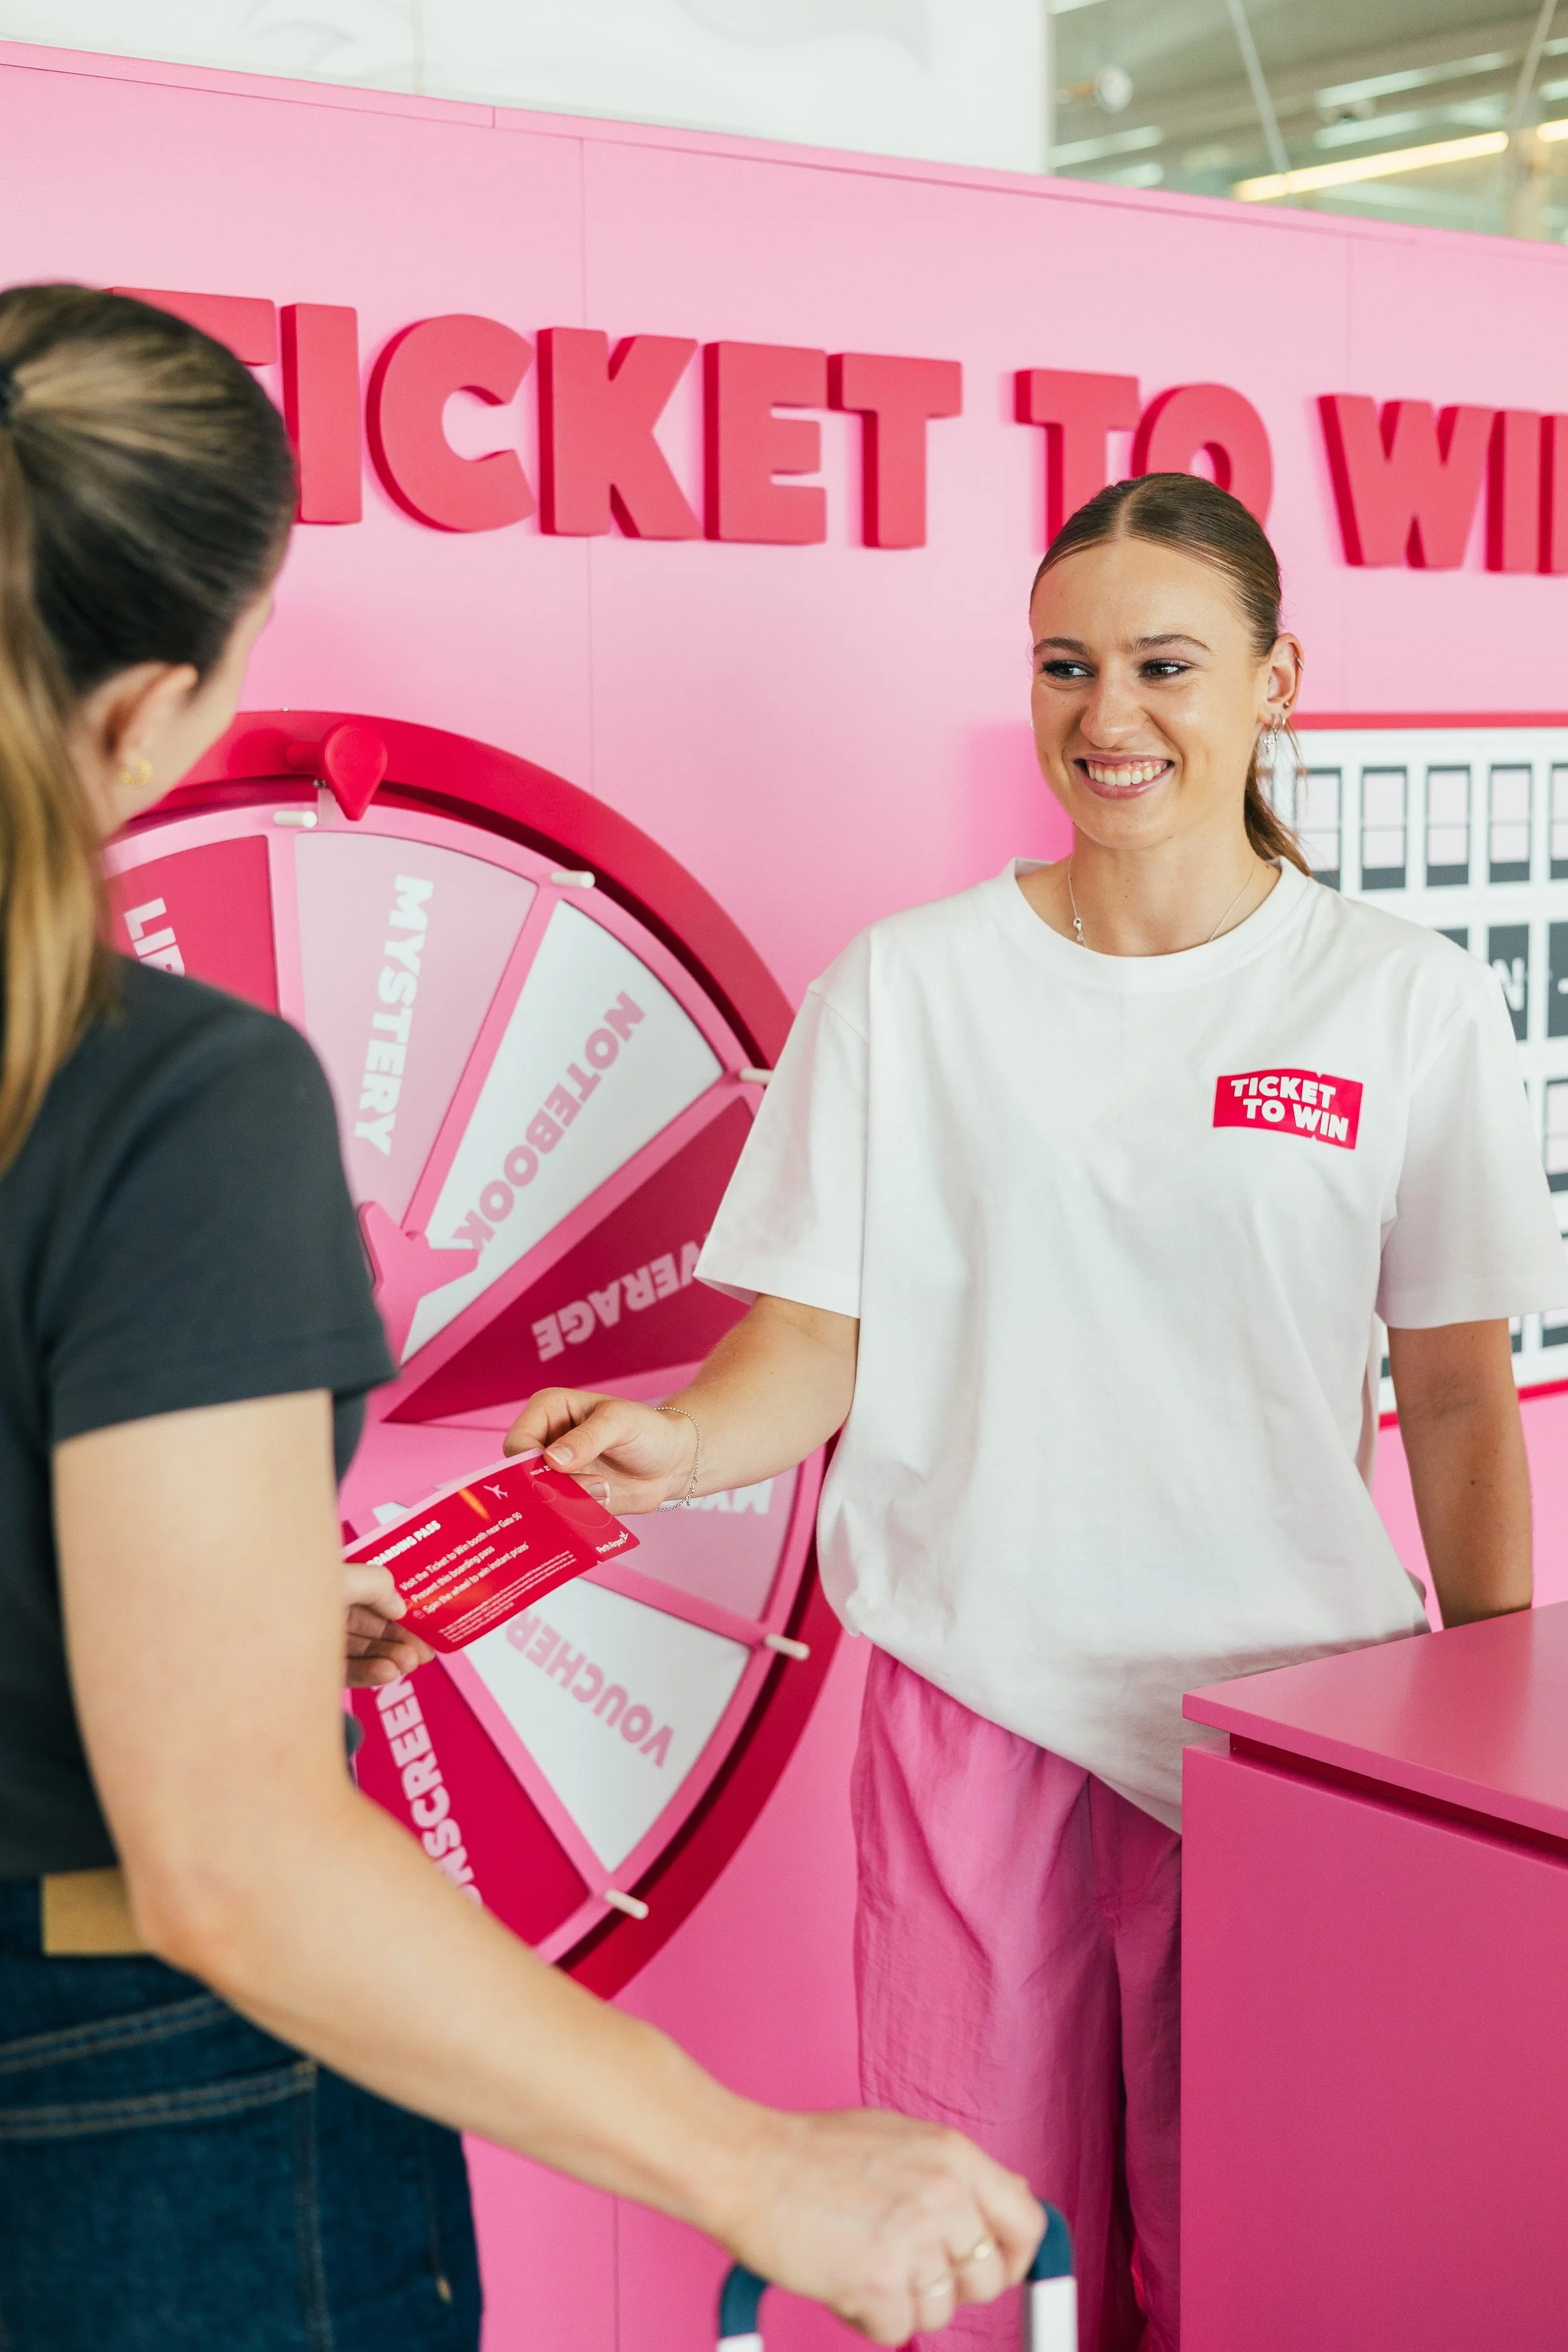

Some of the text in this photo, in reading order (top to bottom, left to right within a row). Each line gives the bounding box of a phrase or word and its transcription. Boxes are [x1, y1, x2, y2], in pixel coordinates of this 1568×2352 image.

[1015, 368, 1273, 551] TO
[1316, 394, 1568, 575] WI
[354, 874, 433, 1156] MYSTERY
[451, 990, 646, 1254] NOTEBOOK
[1231, 1076, 1336, 1109] TICKET
[1242, 1098, 1348, 1142] TO WIN
[531, 1233, 707, 1362] VERAGE
[399, 1512, 522, 1591] Visit the Ticket to Win booth near Gate 50
[413, 1520, 441, 1542] PASS
[596, 1537, 627, 1554] Perth Airport
[410, 1545, 495, 1603] Present this boarding pass
[422, 1601, 442, 1614] Spin
[438, 1593, 452, 1604] the
[452, 1579, 472, 1597] wheel
[469, 1576, 479, 1584] to
[477, 1567, 491, 1578] win
[487, 1552, 512, 1571] instant
[505, 1609, 674, 1767] VOUCHER
